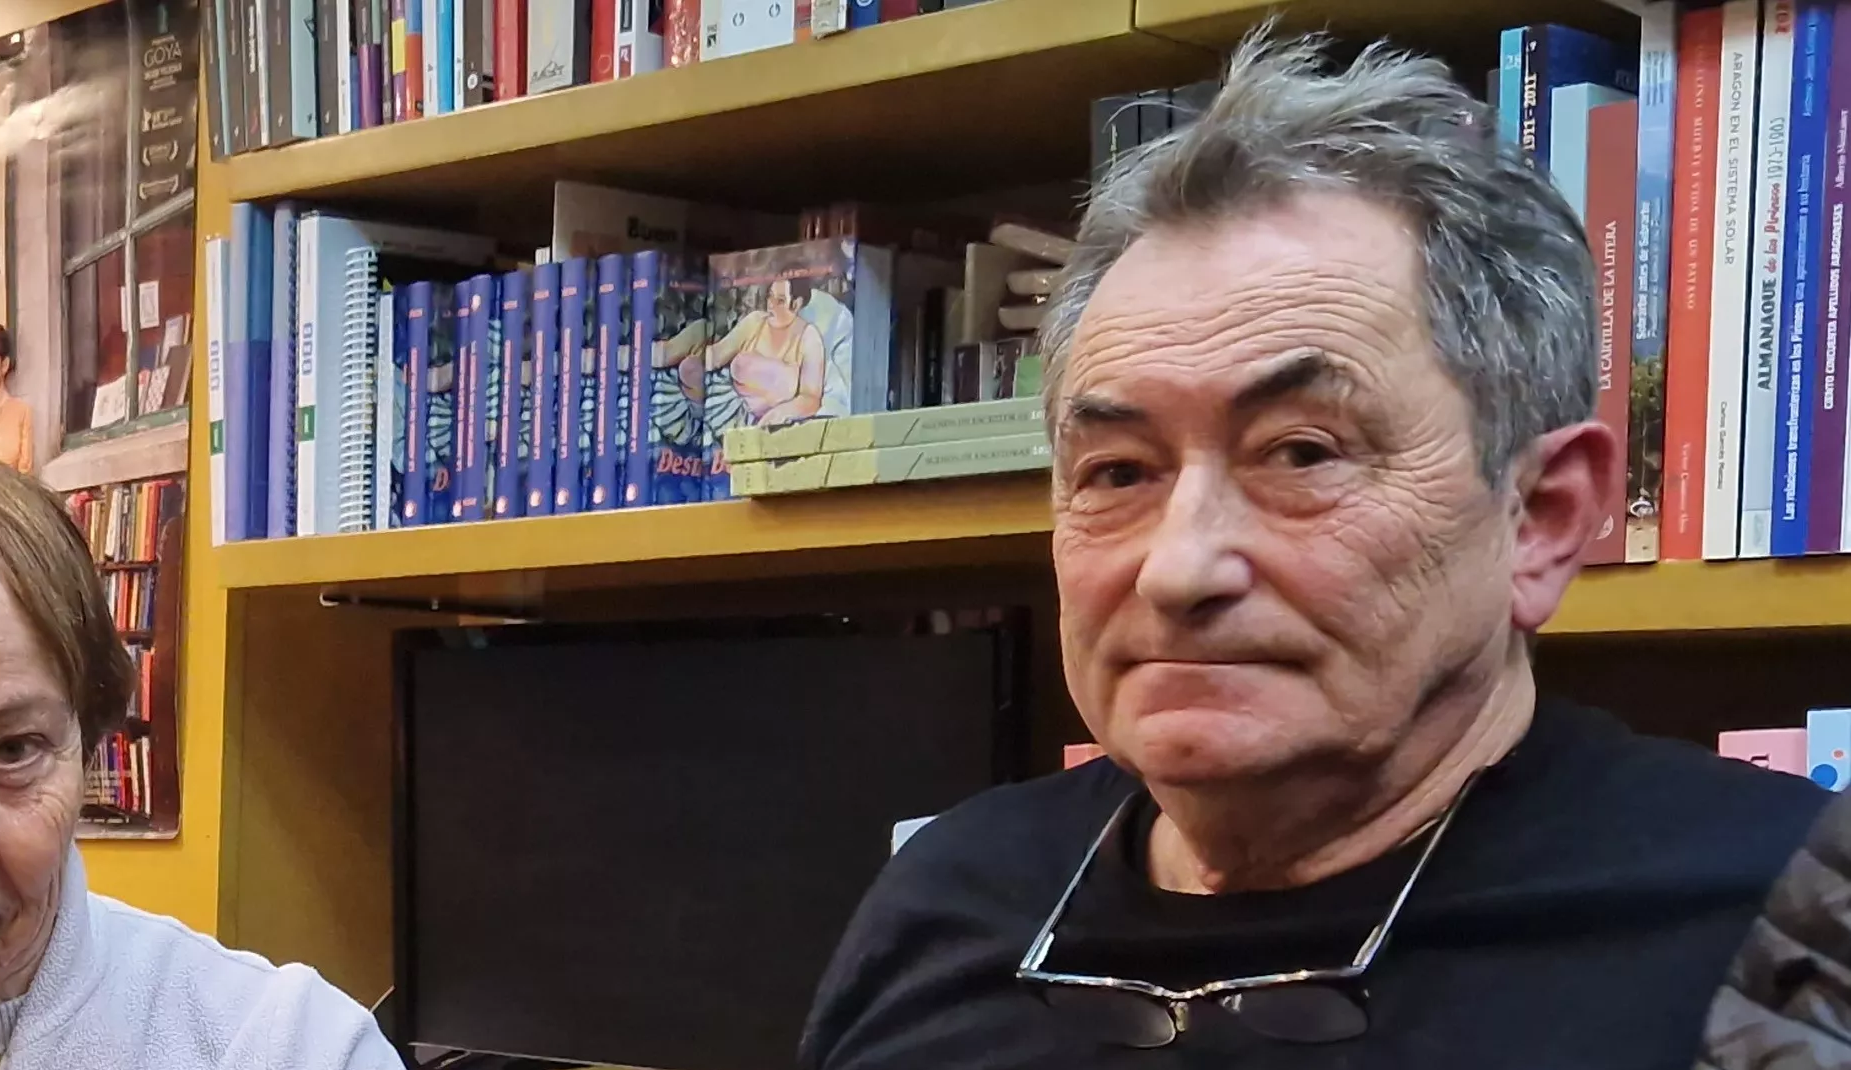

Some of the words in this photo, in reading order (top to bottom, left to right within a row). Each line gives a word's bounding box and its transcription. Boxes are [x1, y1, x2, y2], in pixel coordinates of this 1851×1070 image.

[144, 42, 182, 68] GOYA
[1524, 72, 1537, 109] 2011
[1729, 115, 1741, 134] EN
[1729, 138, 1740, 154] EL
[1726, 157, 1739, 216] SISTEMA
[1763, 182, 1781, 234] Pirineos
[1605, 221, 1617, 266] LITERA
[1724, 219, 1737, 265] SOLAR
[1763, 238, 1778, 255] los
[1604, 267, 1616, 287] LA
[1763, 259, 1776, 273] de
[1603, 287, 1615, 307] DE
[1791, 302, 1804, 342] Pirineos
[1601, 309, 1615, 371] CARTILLA
[1756, 278, 1778, 390] ALMANAQUE
[1789, 343, 1802, 359] los
[1791, 360, 1802, 373] en
[1599, 373, 1612, 390] LA
[1784, 452, 1798, 501] relaciones
[1783, 502, 1795, 520] Las
